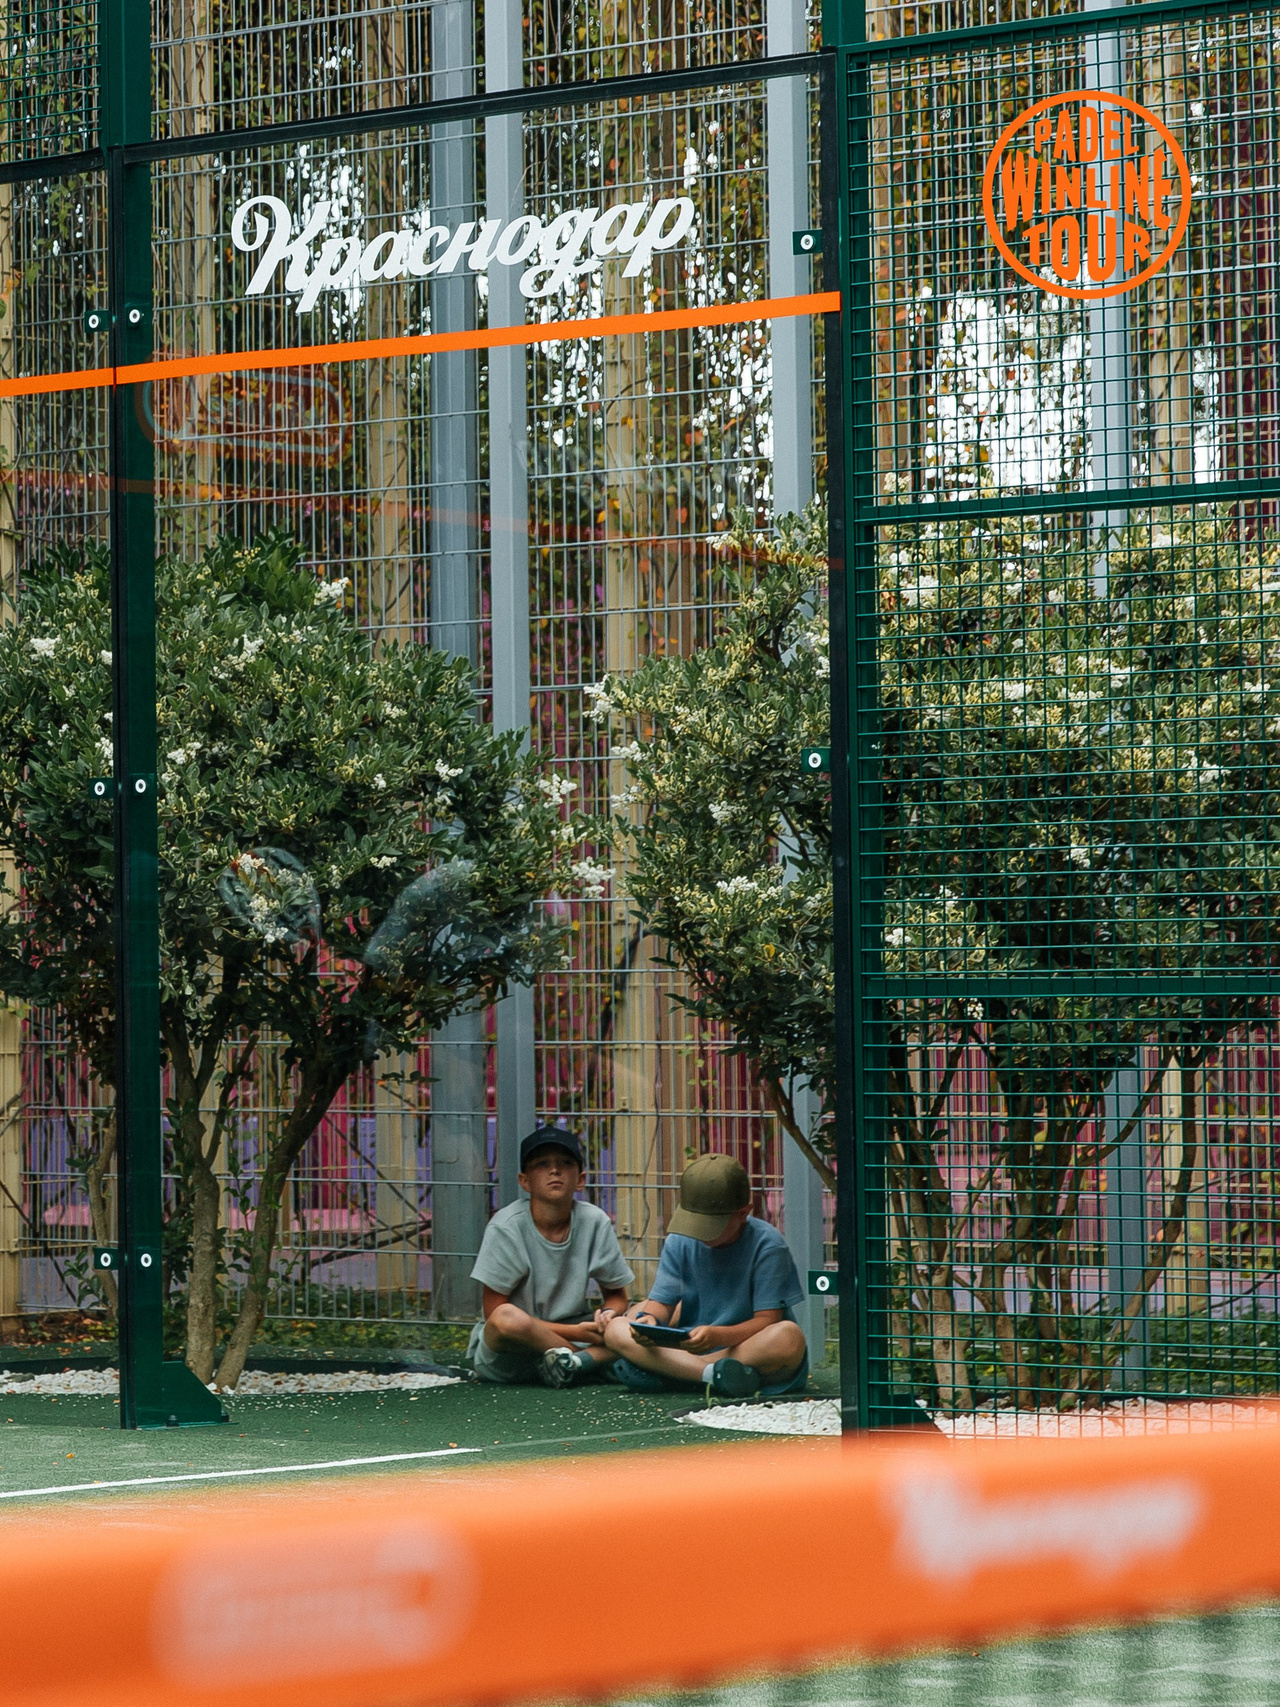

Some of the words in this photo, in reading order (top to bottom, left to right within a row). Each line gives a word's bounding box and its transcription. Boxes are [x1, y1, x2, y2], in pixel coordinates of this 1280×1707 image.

[1034, 106, 1140, 162] PADEL
[1001, 147, 1172, 232] WINLINE
[231, 194, 695, 313] Краснодар
[1022, 214, 1151, 282] TOUR
